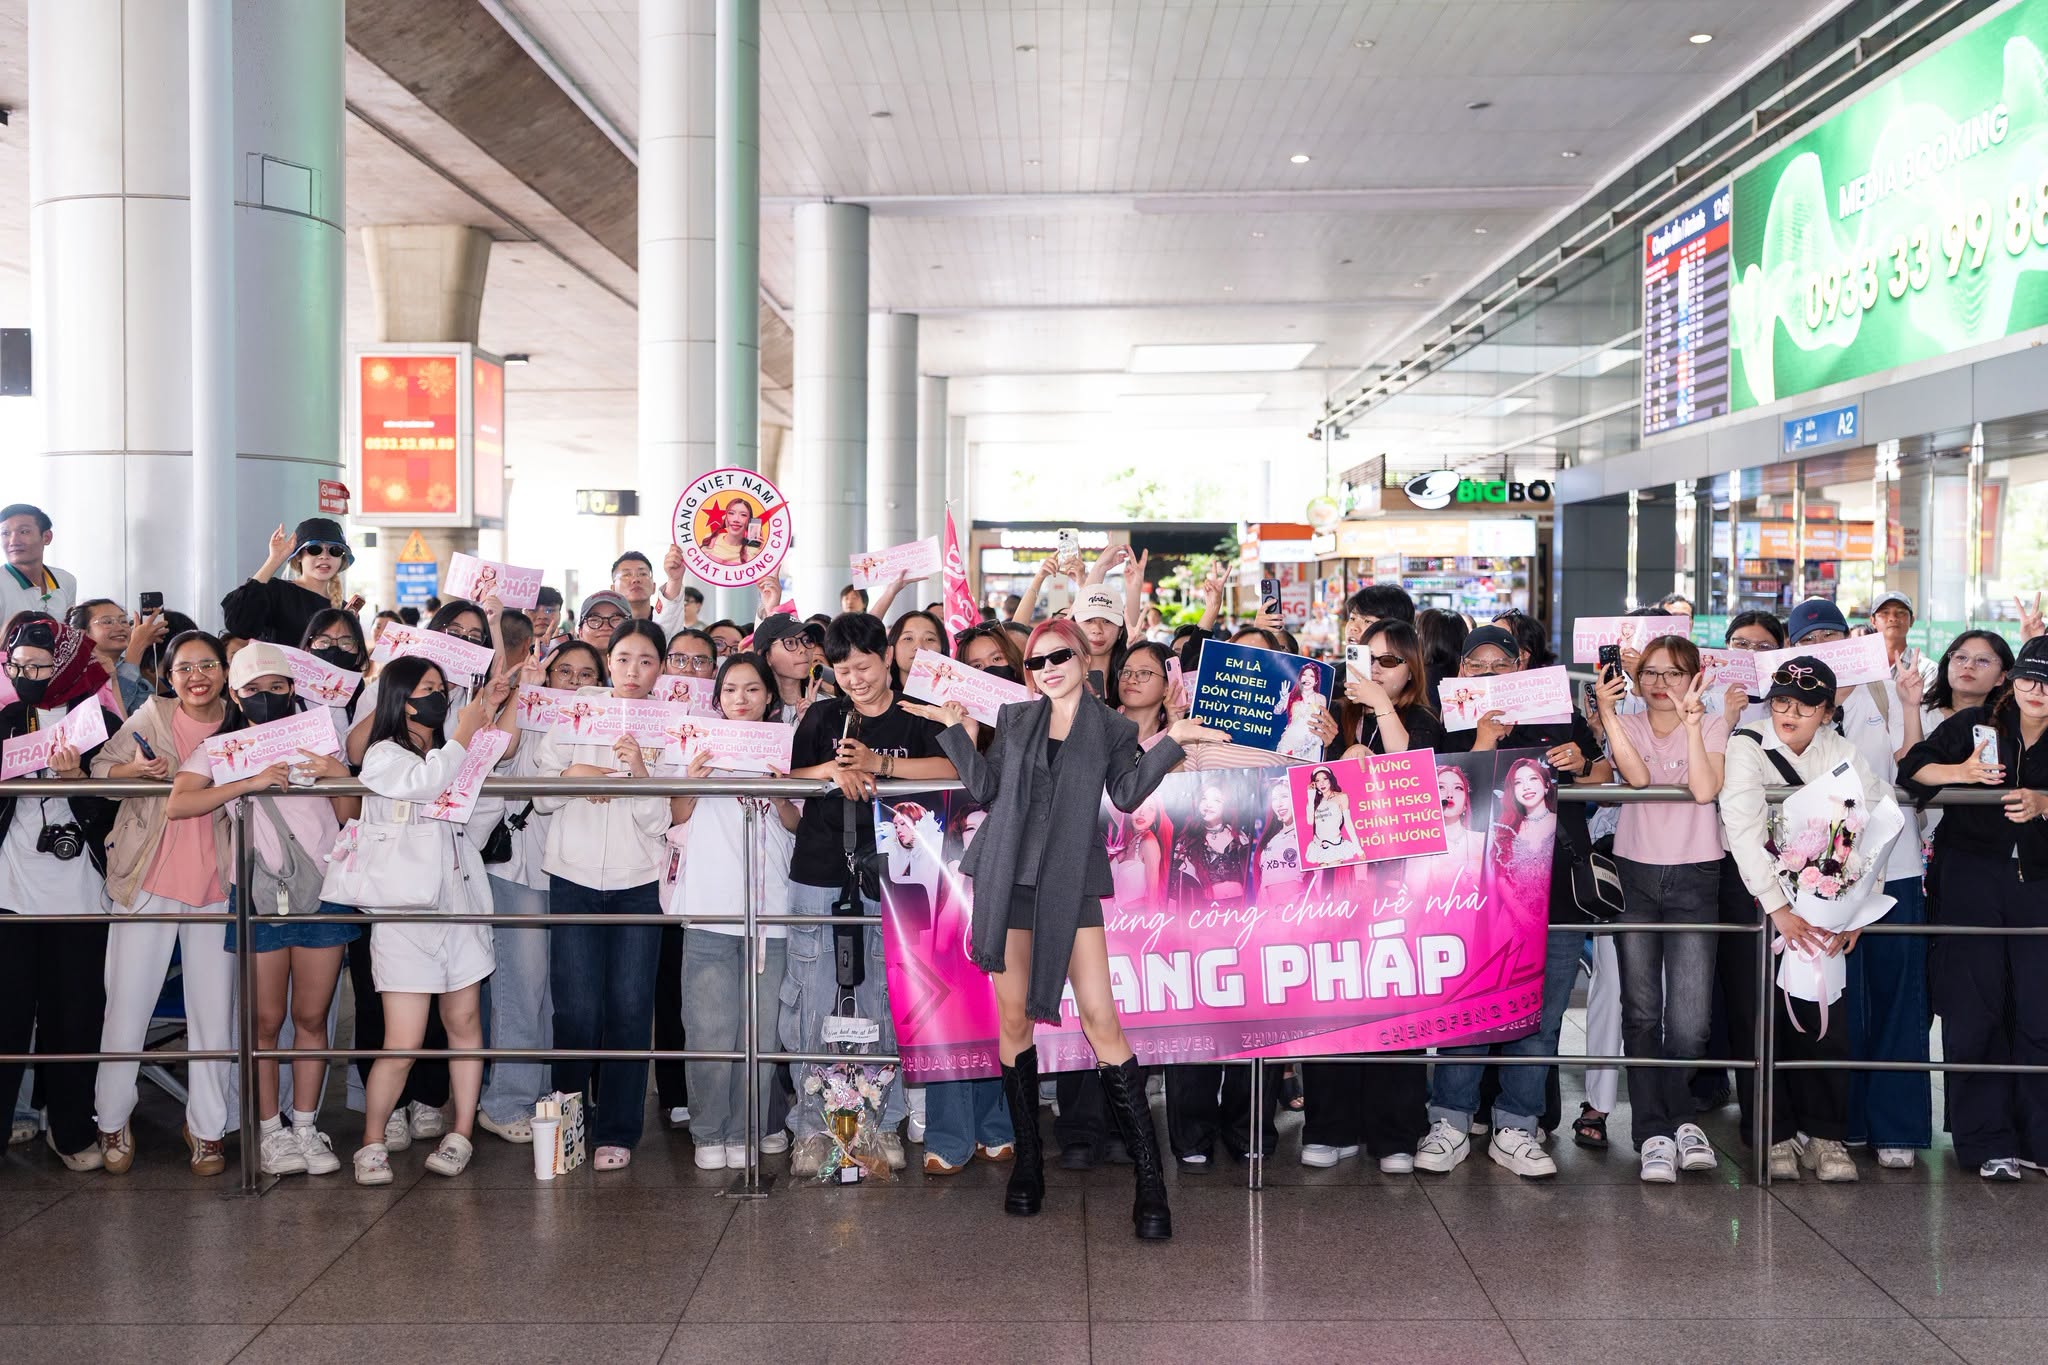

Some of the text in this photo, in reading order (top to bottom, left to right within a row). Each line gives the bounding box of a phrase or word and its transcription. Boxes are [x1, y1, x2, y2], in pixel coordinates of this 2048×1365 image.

[1840, 103, 2008, 220] MEDIA BOOKING
[1805, 251, 1878, 329] 0933
[1888, 223, 1930, 299] 33
[1942, 199, 1992, 278] 99
[1837, 411, 1853, 436] A2
[678, 474, 774, 543] HÀNG VIỆT NAM
[725, 553, 774, 581] LƯỢNG
[771, 518, 783, 549] CAO
[1225, 657, 1262, 673] EM LÀ
[1215, 671, 1268, 689] KANDEE!
[1201, 684, 1276, 706] ĐÓN CHỊ HAI
[1199, 699, 1273, 721] THÙY TRANG
[1215, 717, 1241, 731] HỌC
[1243, 722, 1272, 736] SINH
[1369, 759, 1411, 775] MỪNG
[1365, 776, 1420, 794] DU HỌC
[1358, 793, 1432, 812] SINH HSK9
[1354, 808, 1441, 830] CHÍNH THỨC
[1389, 827, 1441, 845] HƯƠNG
[1104, 866, 1489, 954] ừng công chúa về nhà
[1061, 918, 1466, 1016] ANG PHÁP
[1133, 1035, 1216, 1055] FOREVER
